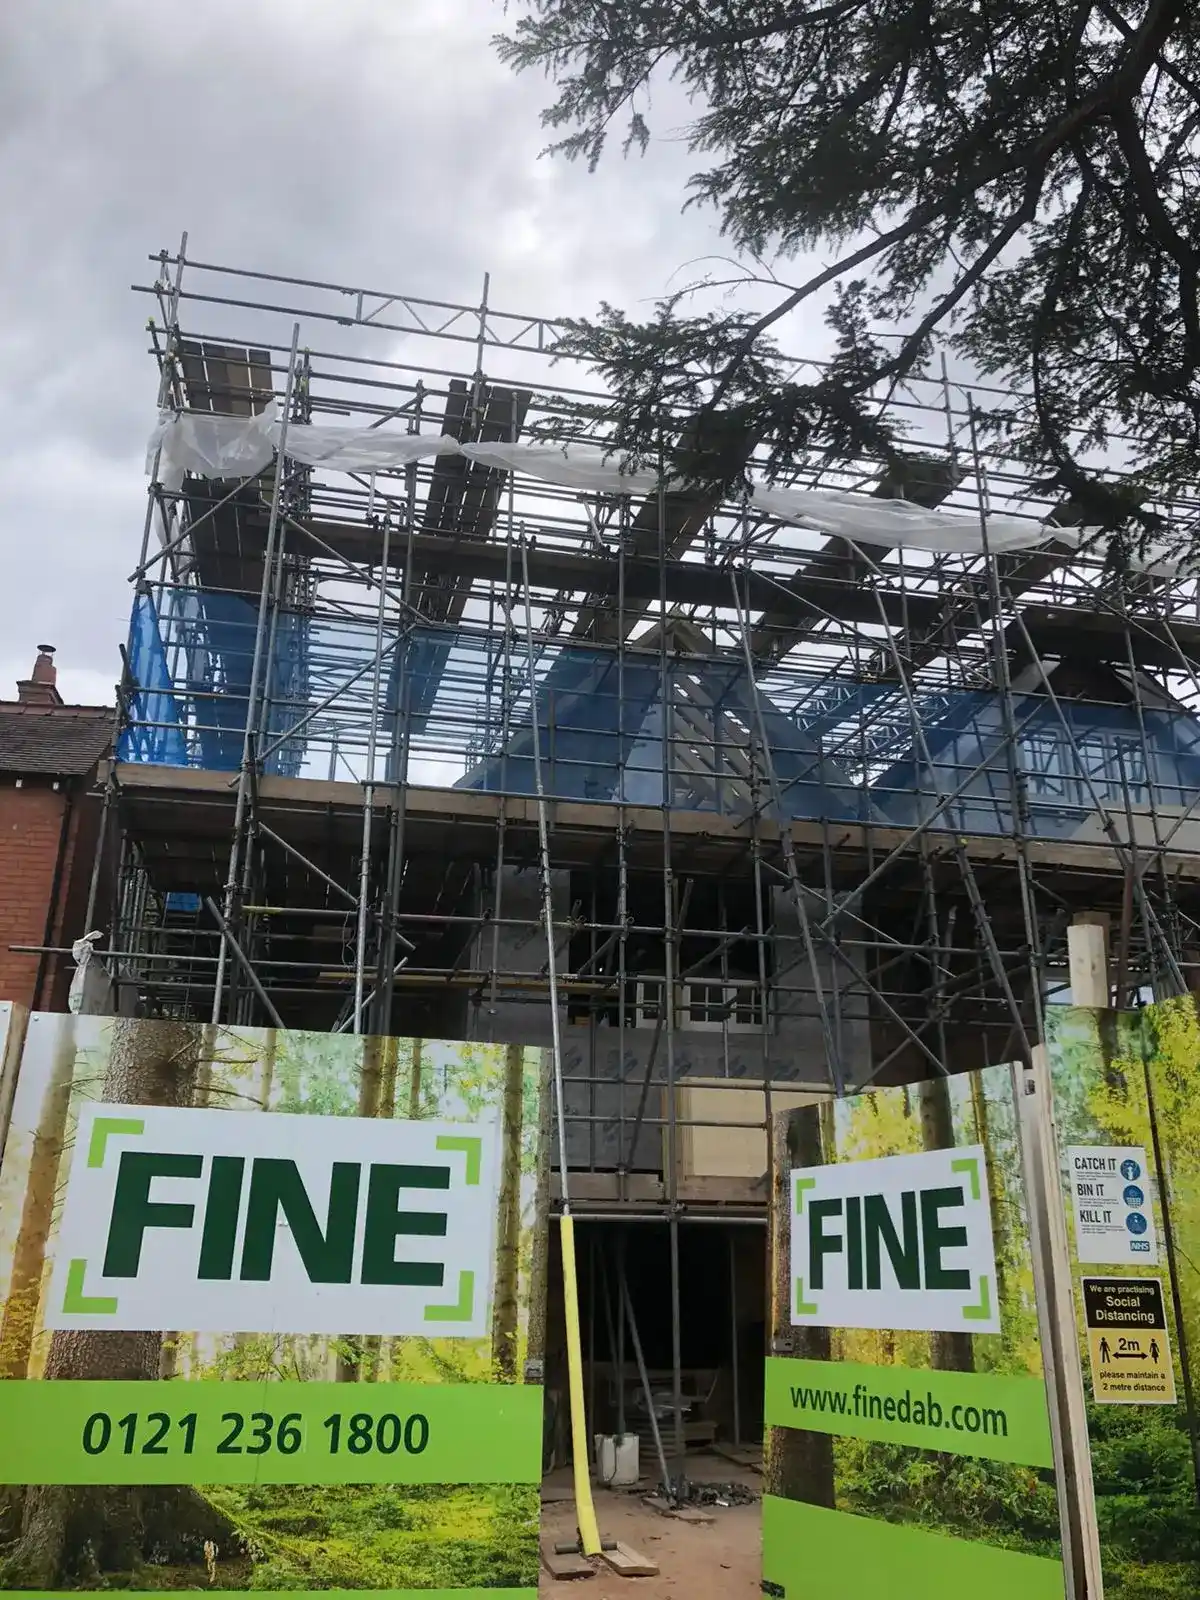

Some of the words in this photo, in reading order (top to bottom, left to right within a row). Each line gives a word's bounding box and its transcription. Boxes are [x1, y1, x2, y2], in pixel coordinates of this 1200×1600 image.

[1074, 1157, 1106, 1171] CATCH
[1107, 1158, 1117, 1171] IT
[1077, 1183, 1094, 1196] BIN
[1096, 1184, 1104, 1196] IT
[102, 1151, 451, 1286] FINE
[1079, 1210, 1101, 1223] KILL
[1103, 1210, 1112, 1223] IT
[808, 1186, 972, 1290] FINE
[1131, 1241, 1149, 1251] NHS
[1089, 1284, 1102, 1292] We
[1117, 1285, 1155, 1295] practising
[1106, 1295, 1140, 1307] Social
[1095, 1309, 1155, 1323] Distancing
[1118, 1337, 1140, 1351] 2m
[1099, 1371, 1126, 1380] please
[1126, 1371, 1159, 1379] maintain
[1109, 1383, 1132, 1391] metre
[1133, 1382, 1166, 1391] distance
[790, 1384, 1009, 1437] www.finedab.com
[82, 1412, 198, 1455] 0121
[216, 1412, 302, 1455] 236
[323, 1412, 430, 1455] 1800
